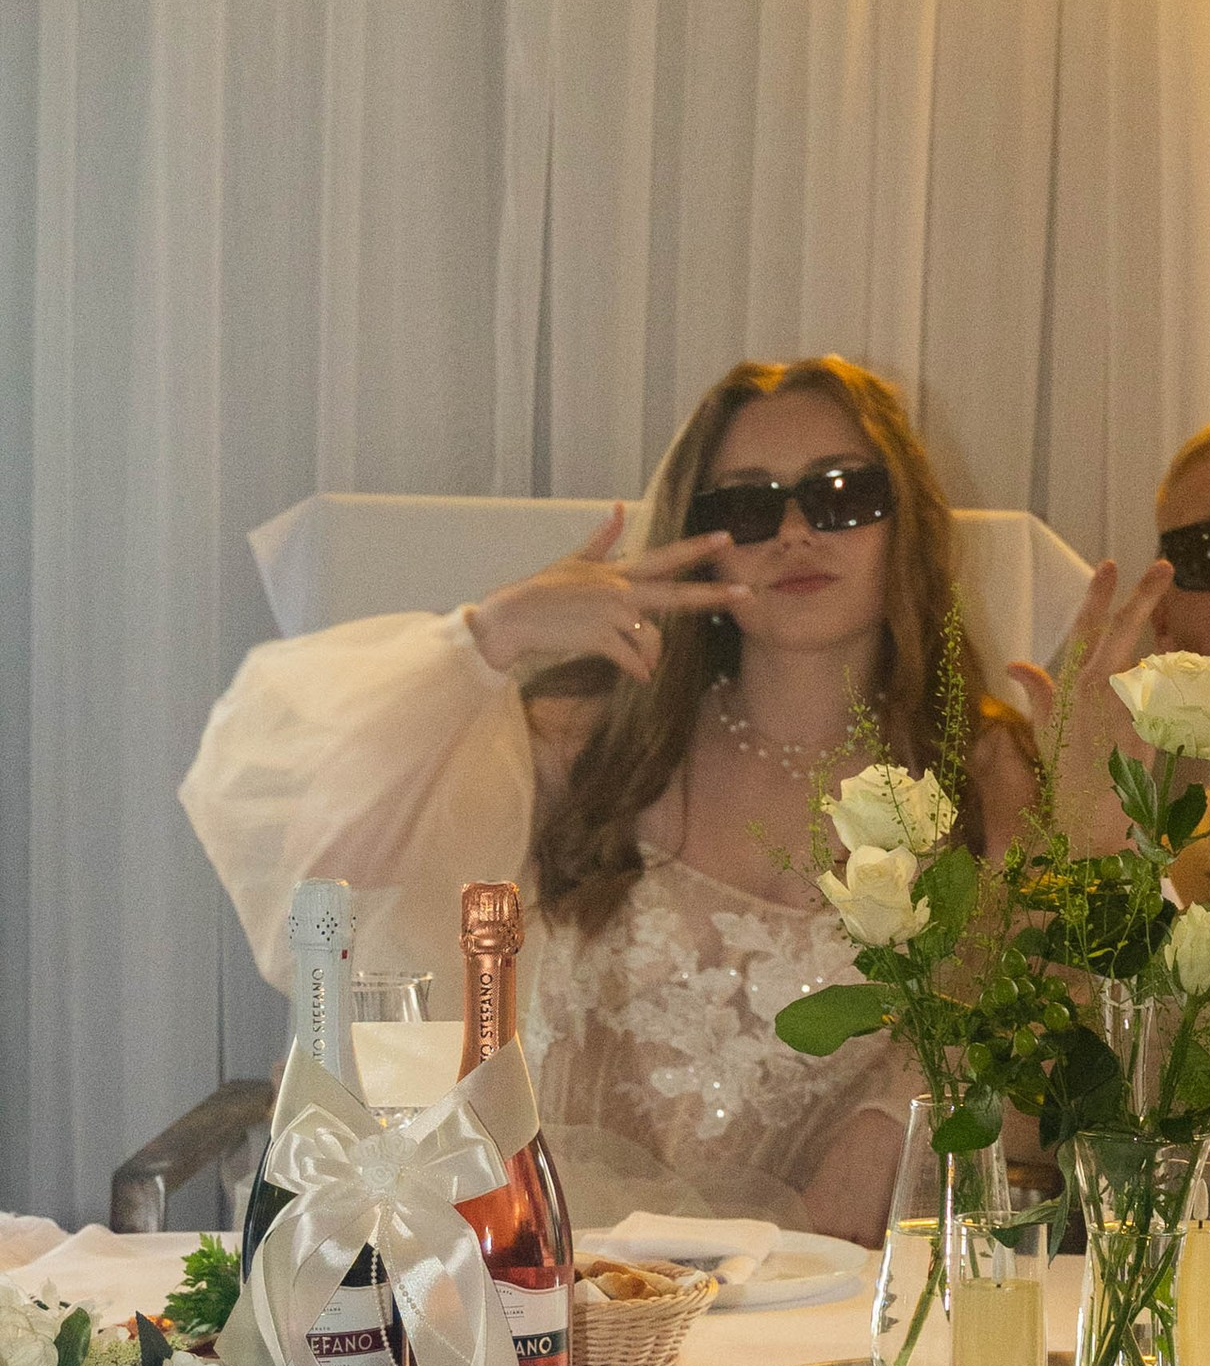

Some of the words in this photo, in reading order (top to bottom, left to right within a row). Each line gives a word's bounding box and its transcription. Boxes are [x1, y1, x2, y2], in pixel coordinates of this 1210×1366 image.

[312, 968, 326, 1033] STEFANO
[480, 973, 493, 1038] STEFANO
[310, 1334, 373, 1354] EFANO
